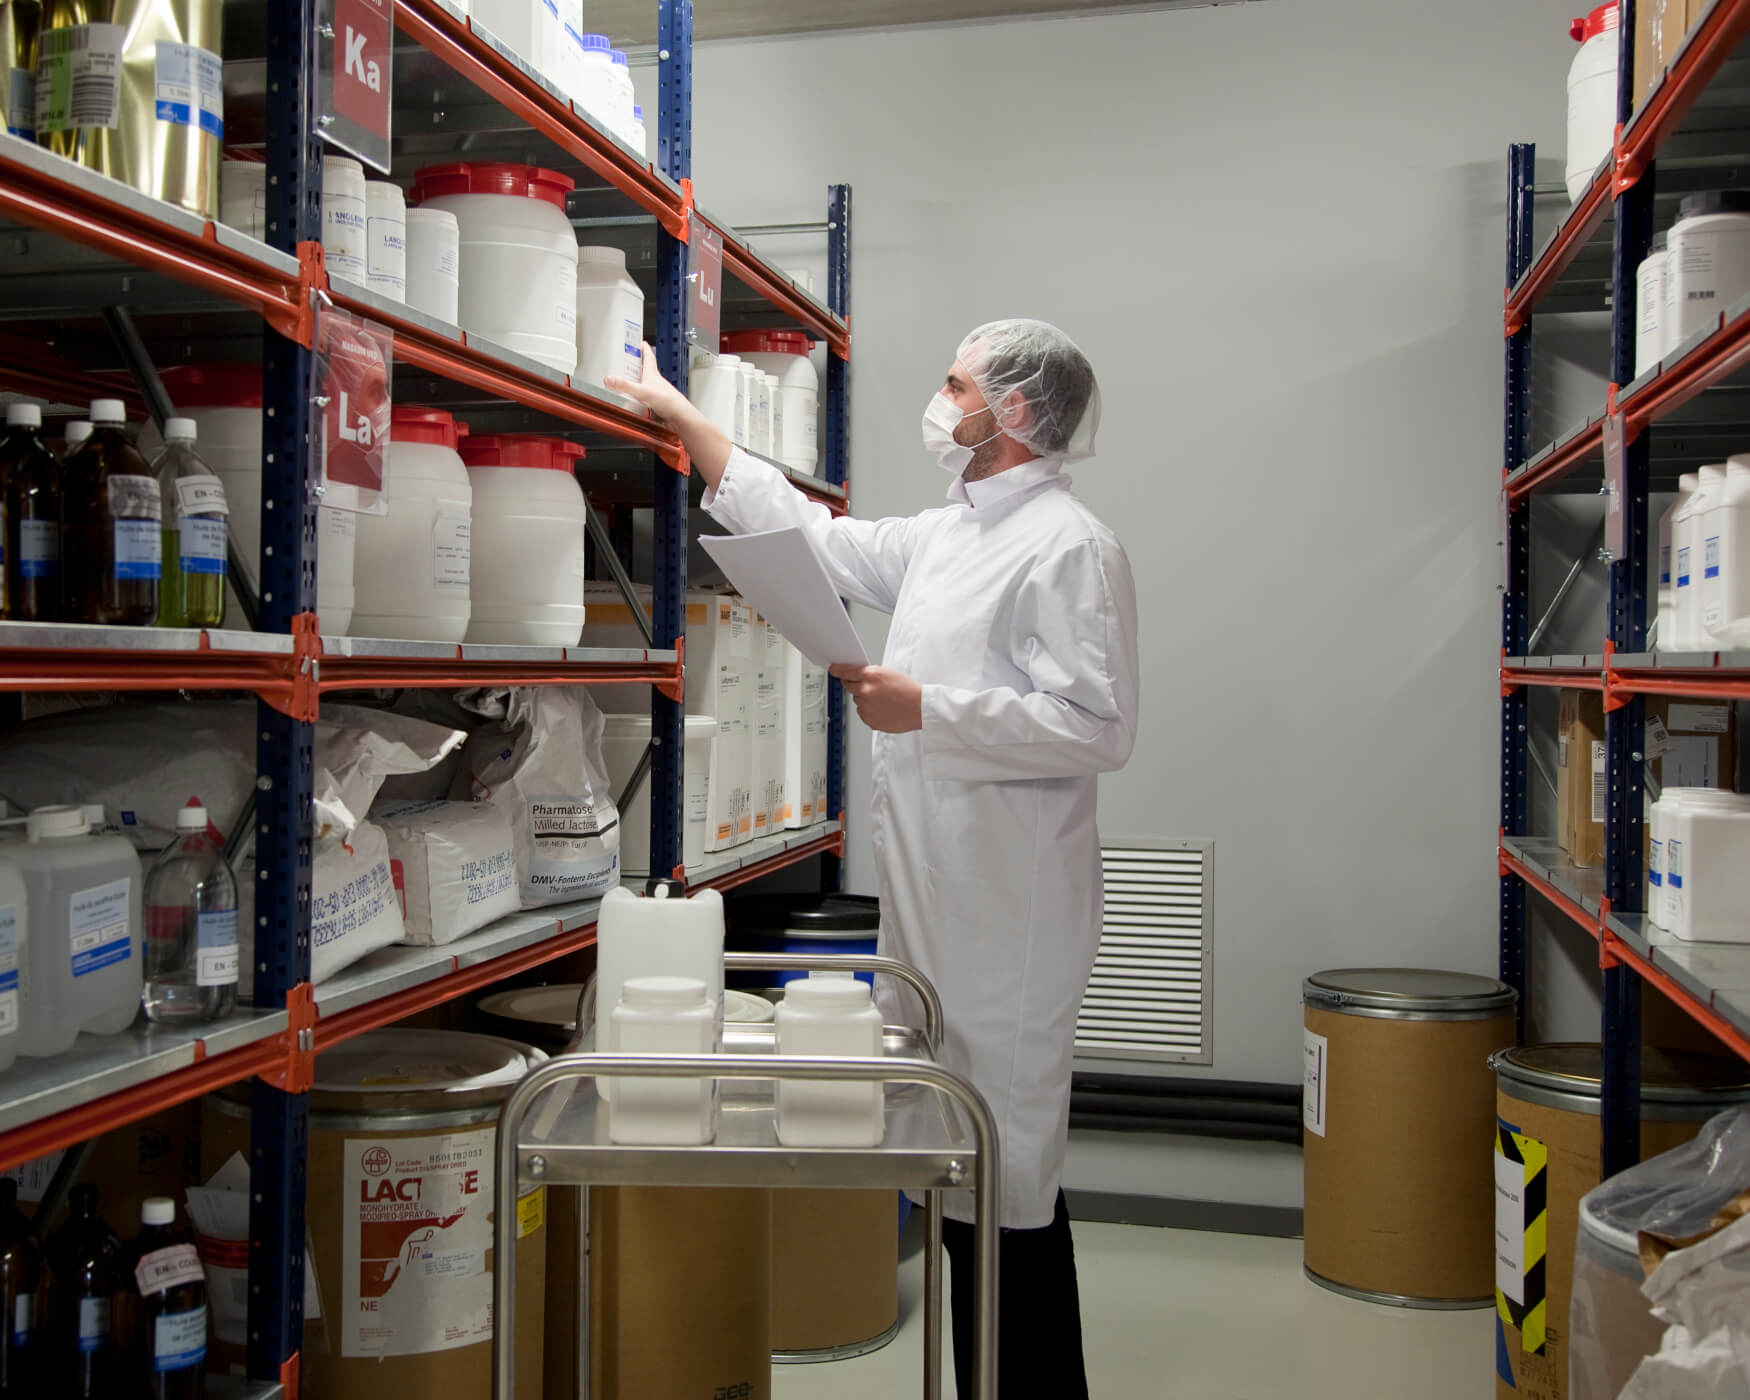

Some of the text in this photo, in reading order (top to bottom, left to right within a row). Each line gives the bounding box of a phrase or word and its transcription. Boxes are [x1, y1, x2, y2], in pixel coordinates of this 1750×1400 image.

[345, 24, 380, 94] Ka
[700, 270, 714, 307] Lu
[339, 391, 371, 445] La
[532, 804, 593, 815] Pharmatose
[534, 820, 598, 831] Milled lactose
[531, 875, 586, 884] DMV-Fonterra
